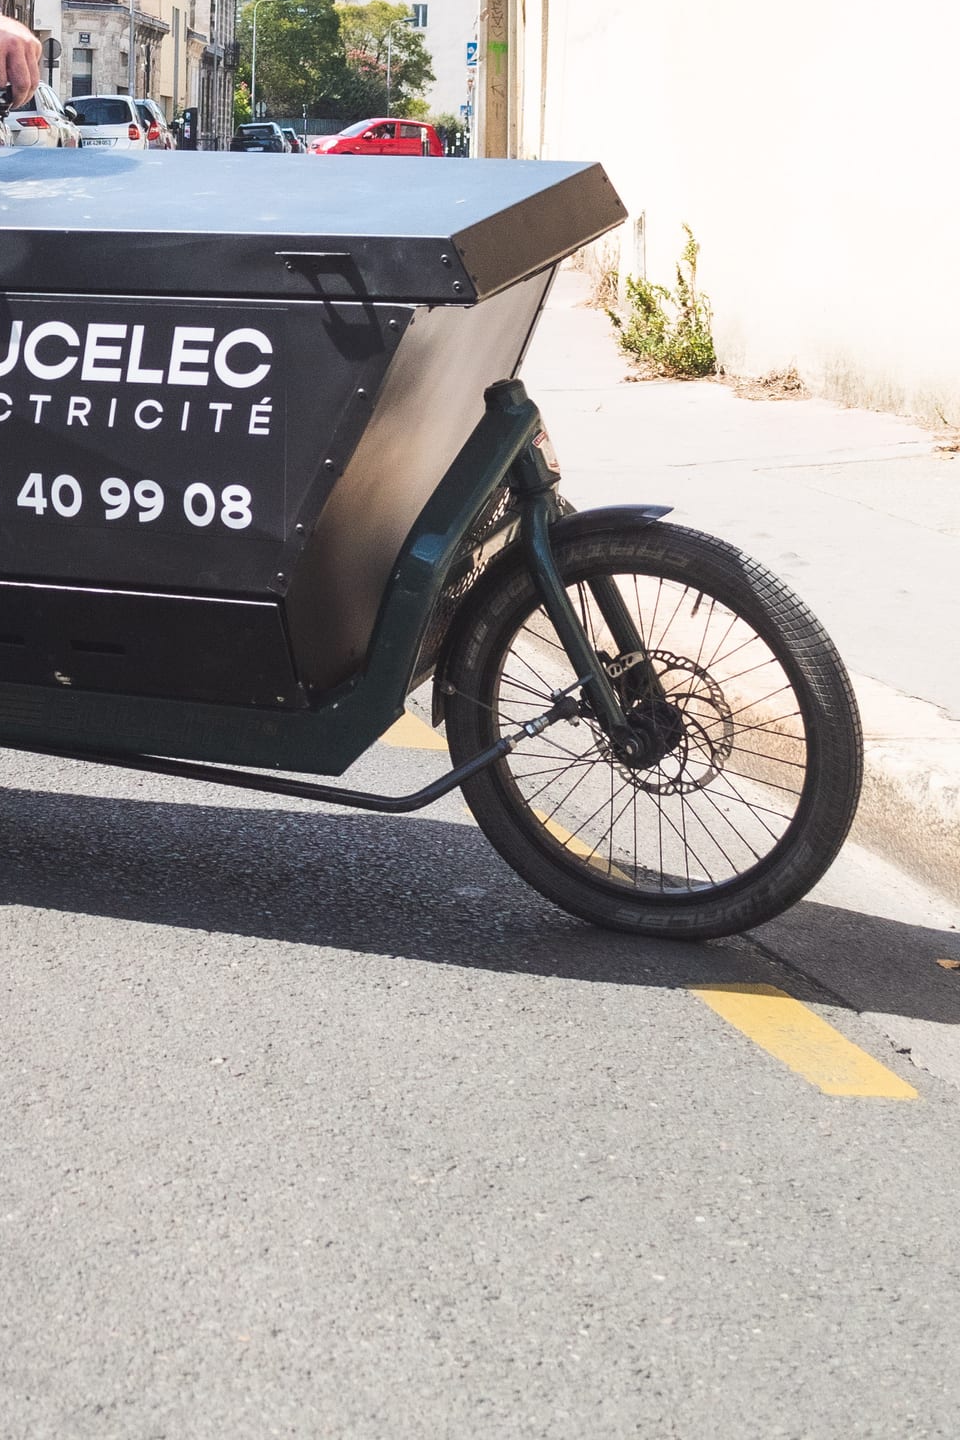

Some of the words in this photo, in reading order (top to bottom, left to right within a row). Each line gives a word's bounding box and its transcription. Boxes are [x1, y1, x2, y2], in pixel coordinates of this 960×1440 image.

[17, 473, 82, 518] 40
[100, 478, 164, 523] 99
[184, 483, 253, 530] 08
